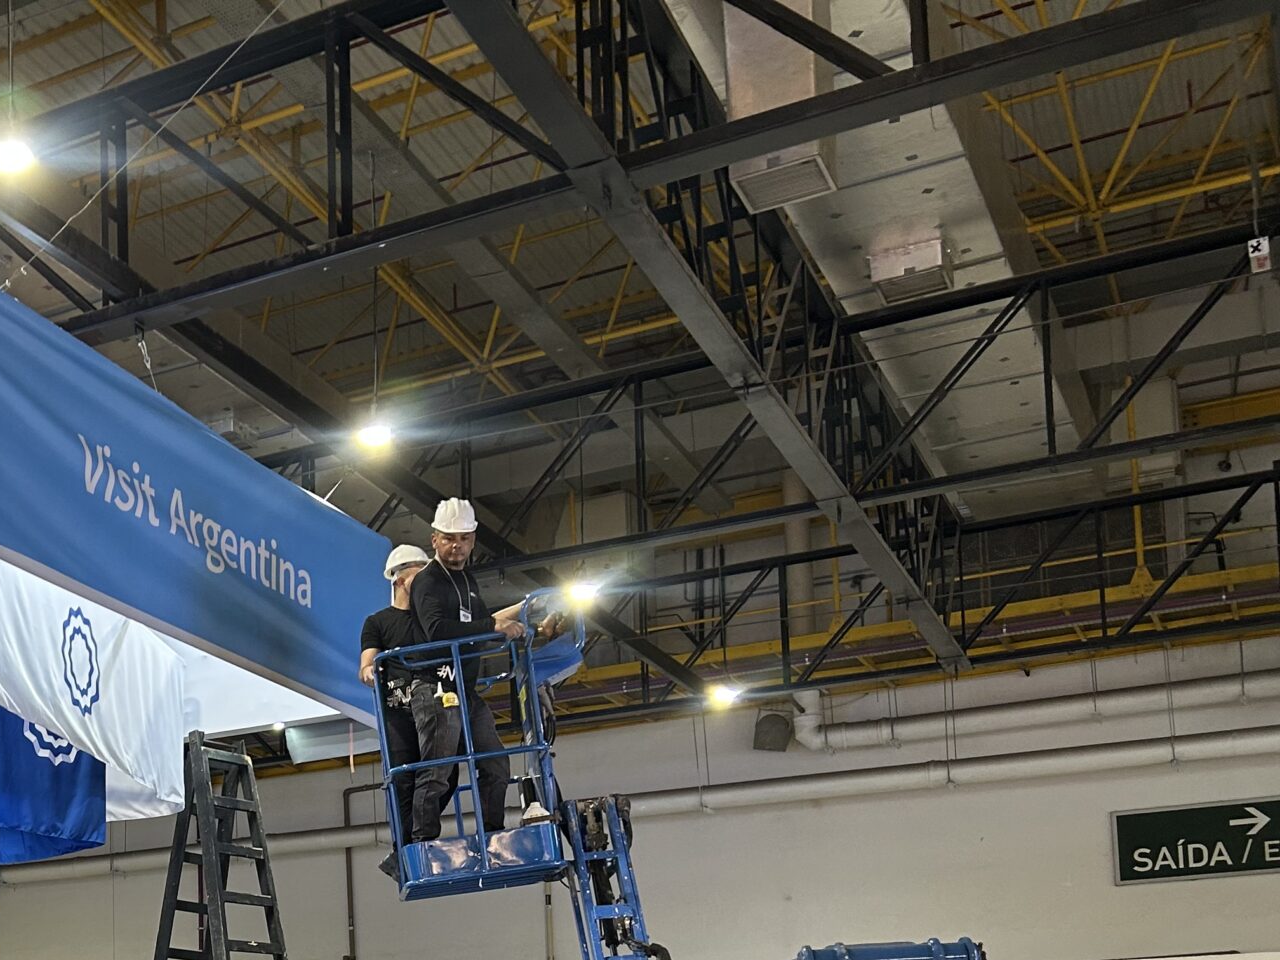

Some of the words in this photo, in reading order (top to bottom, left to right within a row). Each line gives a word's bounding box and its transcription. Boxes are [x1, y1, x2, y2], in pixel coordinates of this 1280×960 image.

[78, 433, 160, 527] Visit
[170, 488, 312, 608] Argentina
[1133, 839, 1233, 872] SAÍDA
